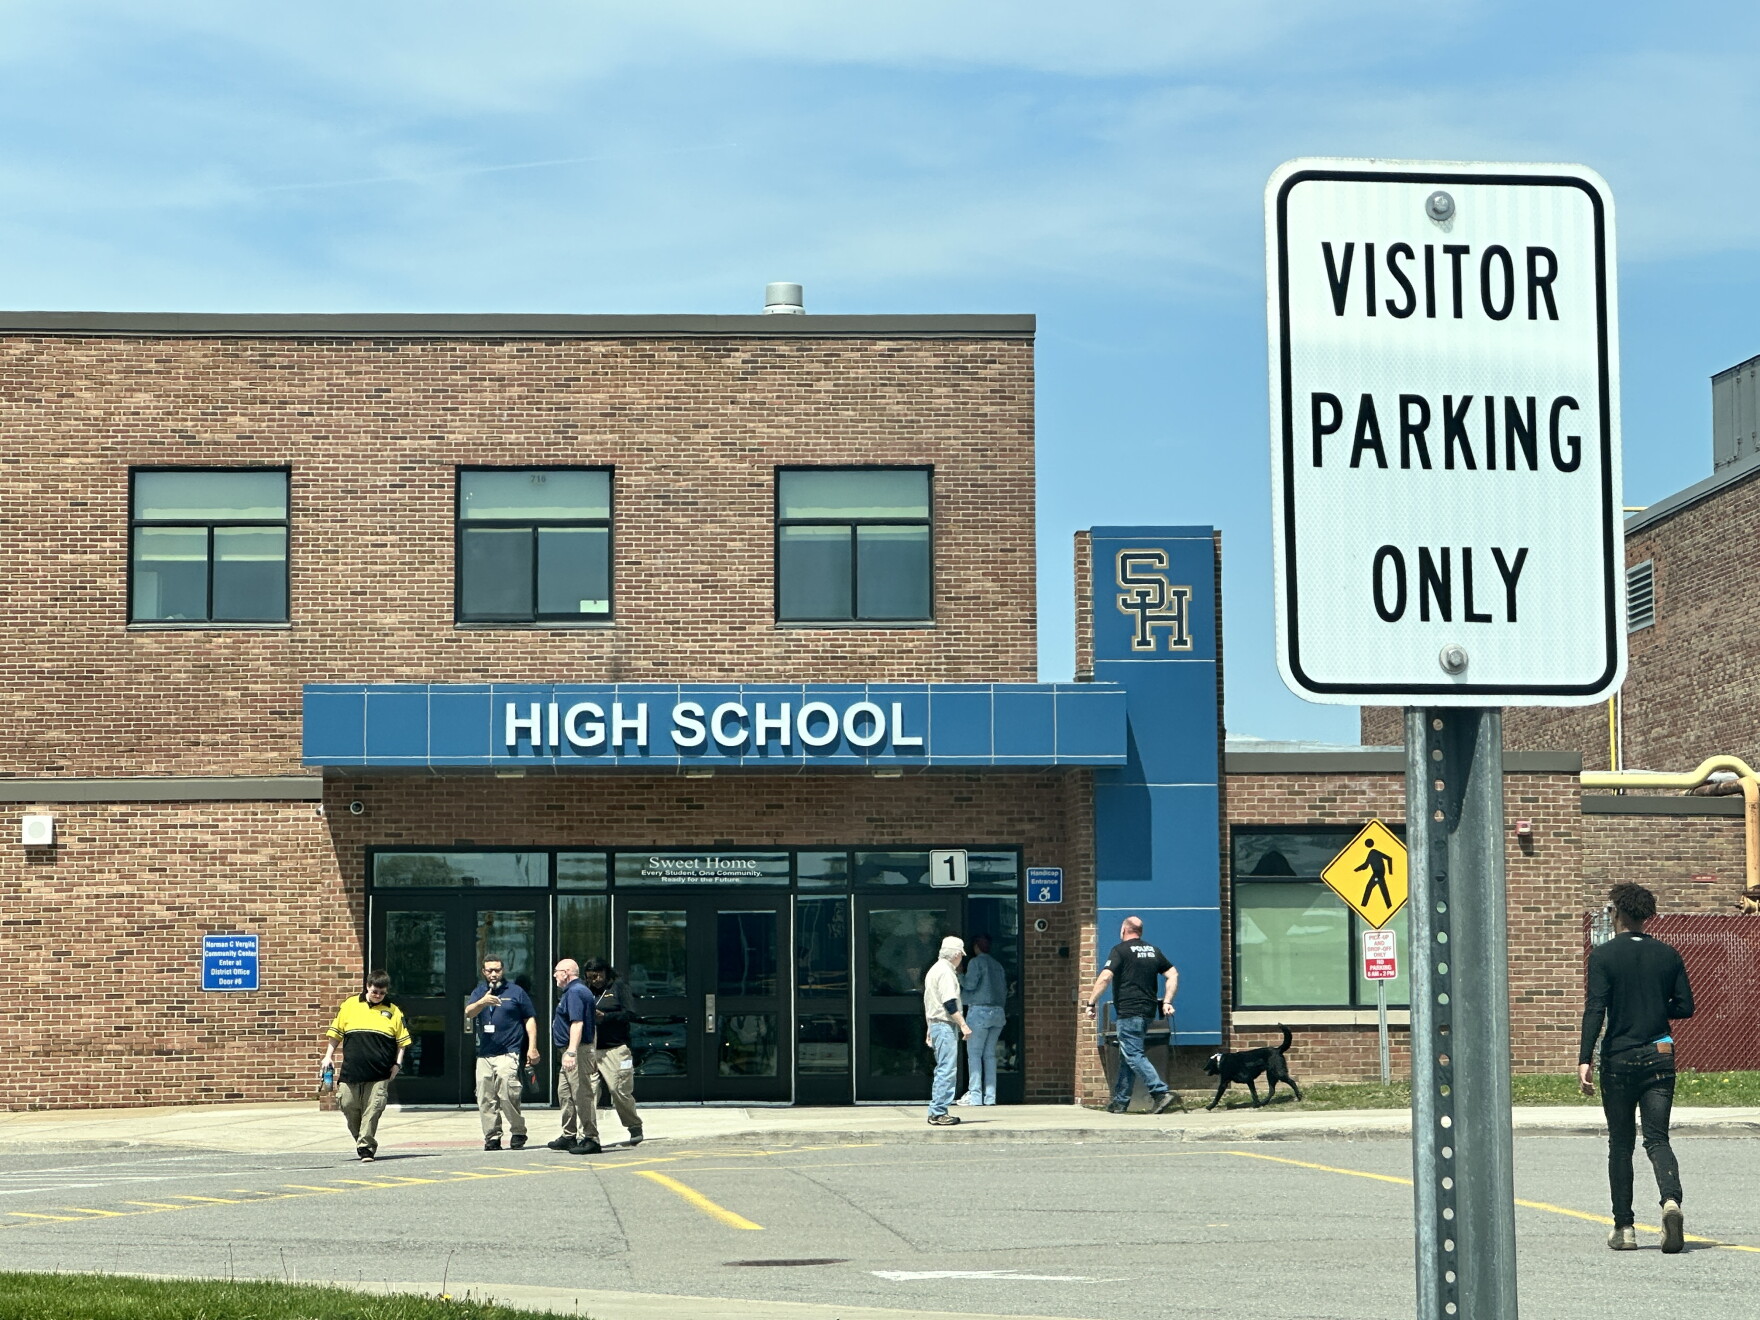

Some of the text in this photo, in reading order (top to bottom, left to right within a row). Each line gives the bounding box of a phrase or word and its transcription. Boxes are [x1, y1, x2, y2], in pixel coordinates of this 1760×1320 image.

[1322, 241, 1559, 320] VISITOR
[1310, 392, 1582, 473] PARKING
[1372, 544, 1528, 623] ONLY
[505, 701, 923, 748] HIGH SCHOOL
[649, 856, 757, 869] Sweet Home
[943, 855, 955, 881] 1
